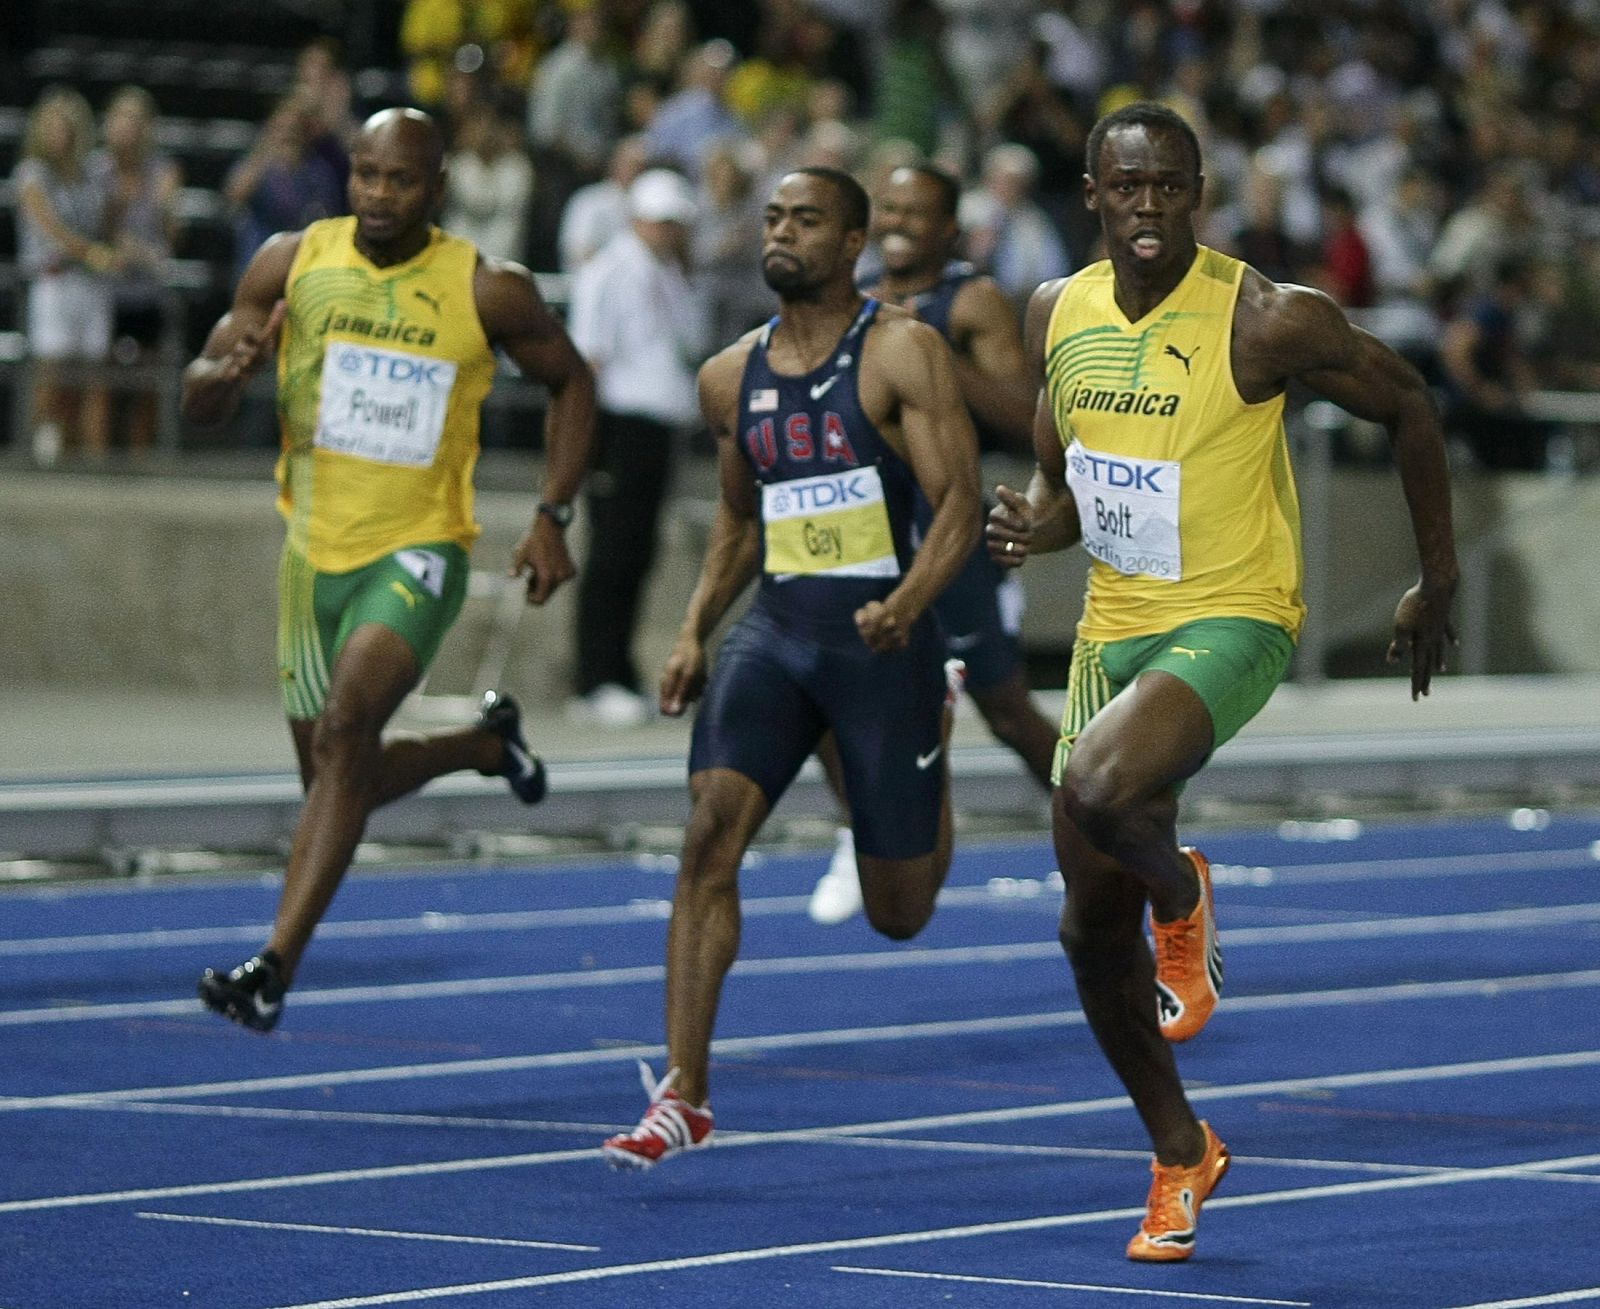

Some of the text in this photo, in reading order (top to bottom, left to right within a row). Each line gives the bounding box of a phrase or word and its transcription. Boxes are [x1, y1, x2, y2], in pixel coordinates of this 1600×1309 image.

[319, 308, 437, 346] jamaica
[367, 352, 439, 385] TDK
[1067, 381, 1181, 417] jamaica
[747, 411, 860, 472] USA
[1085, 454, 1164, 493] TDK
[790, 476, 866, 511] TDK
[1095, 497, 1134, 539] Bolt
[803, 520, 841, 560] Gay
[1125, 556, 1171, 576] 2009
